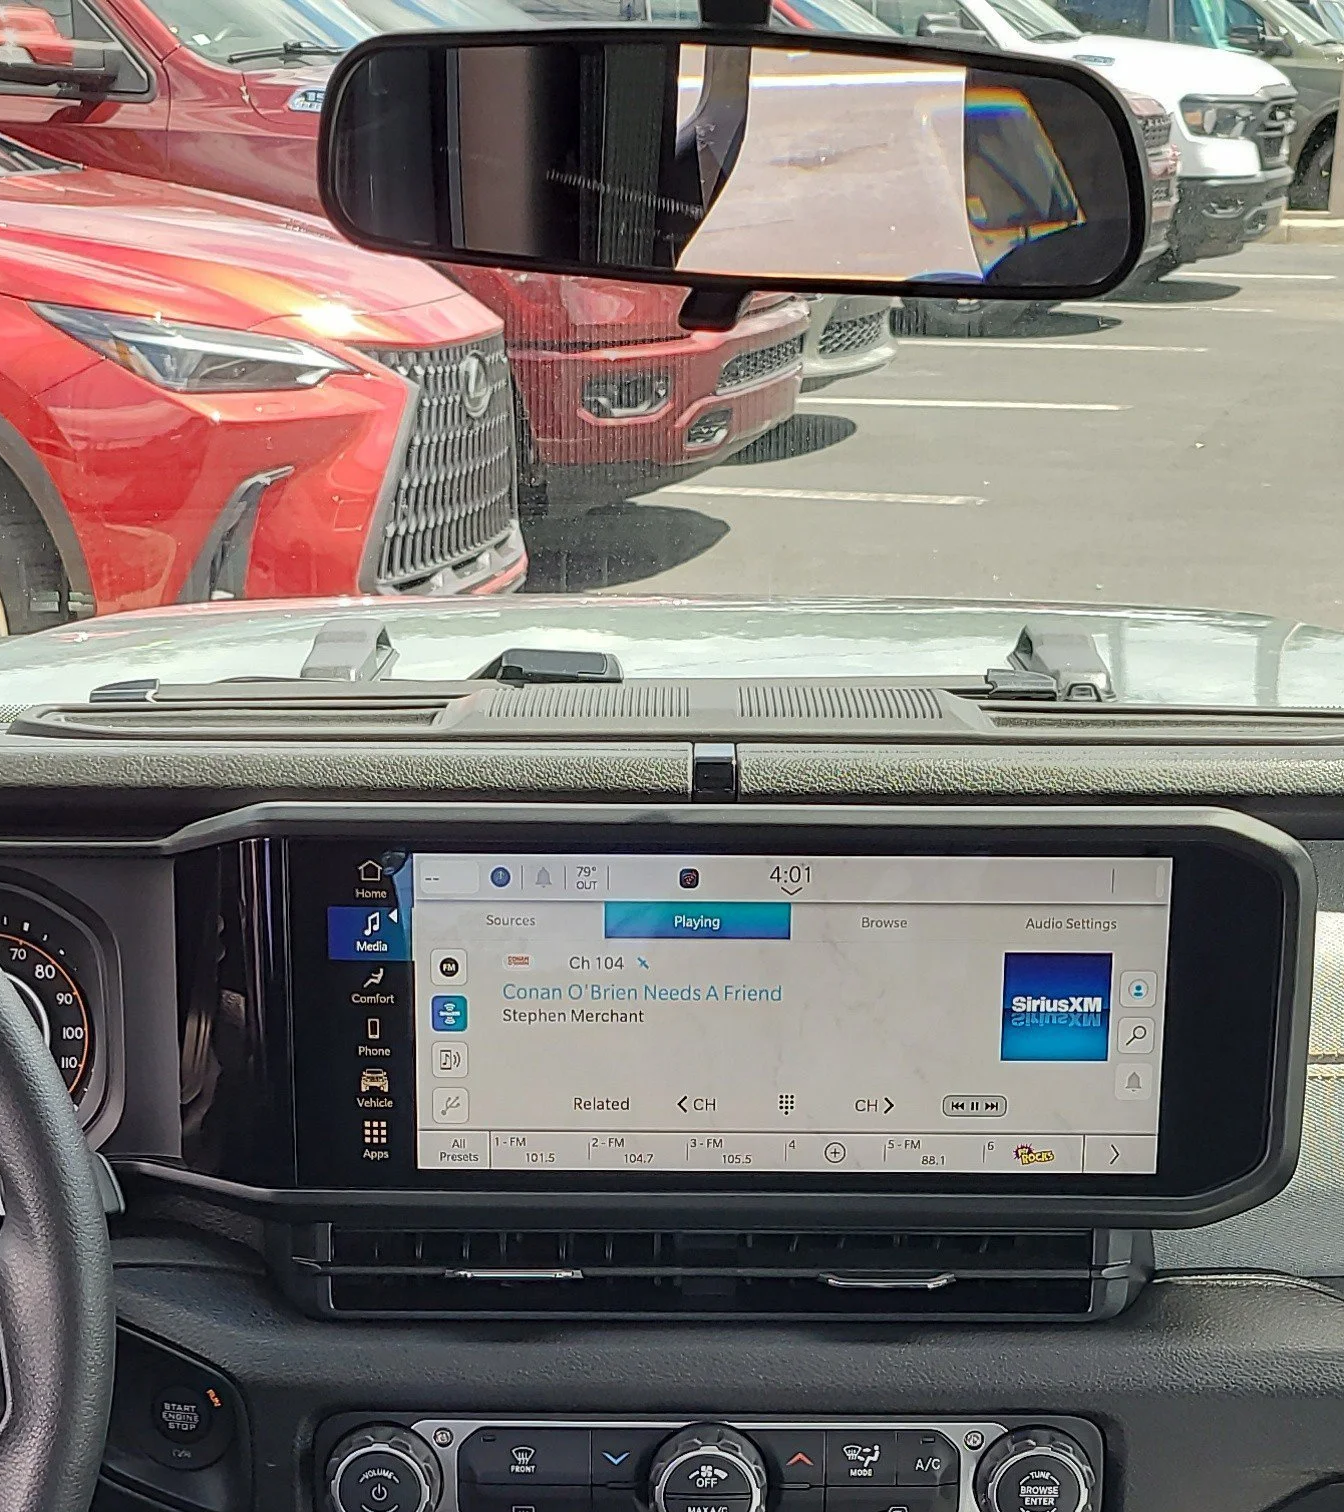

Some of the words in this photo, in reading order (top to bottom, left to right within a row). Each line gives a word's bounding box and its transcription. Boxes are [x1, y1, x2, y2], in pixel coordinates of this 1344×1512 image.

[769, 866, 813, 884] 4:01
[576, 880, 597, 891] OUT
[355, 888, 387, 899] Home
[486, 914, 536, 927] Sources
[674, 915, 721, 930] Playing
[861, 917, 908, 930] Browse
[1025, 918, 1062, 930] Audio
[1066, 918, 1117, 932] Settings
[356, 941, 388, 952] Media
[10, 948, 27, 961] 70
[569, 956, 590, 970] Ch
[596, 956, 624, 970] 104
[34, 964, 56, 979] 80
[56, 993, 73, 1005] 90
[351, 993, 395, 1004] Comfort
[503, 984, 562, 1001] Conan
[568, 984, 638, 1001] O'Brien
[644, 984, 701, 1001] Needs
[705, 984, 720, 1001] A
[724, 984, 783, 1002] Friend
[1011, 997, 1102, 1013] SiriusXM
[502, 1008, 566, 1026] Stephen
[571, 1008, 644, 1024] Merchant
[62, 1026, 83, 1040] 100
[358, 1045, 391, 1057] Phone
[61, 1056, 77, 1069] 110
[356, 1097, 394, 1109] Vehicle
[573, 1096, 630, 1111] Related
[693, 1098, 716, 1112] CH
[855, 1098, 879, 1113] CH
[451, 1138, 466, 1149] All
[363, 1149, 389, 1160] Apps
[439, 1151, 479, 1163] Presets
[525, 1153, 556, 1164] 101.5
[623, 1153, 653, 1164] 104.7
[722, 1154, 752, 1165] 105.5
[921, 1155, 946, 1166] 88.1
[164, 1402, 197, 1413] START
[162, 1411, 200, 1422] ENGINE
[168, 1422, 196, 1431] STOP
[510, 1464, 536, 1474] FRONT
[915, 1458, 942, 1472] A/C
[362, 1469, 395, 1480] VOLUME
[849, 1468, 873, 1478] MODE
[1029, 1471, 1050, 1480] TUNE
[696, 1477, 719, 1489] OFF
[1020, 1485, 1059, 1494] BROWSE
[1024, 1497, 1055, 1506] ENTER
